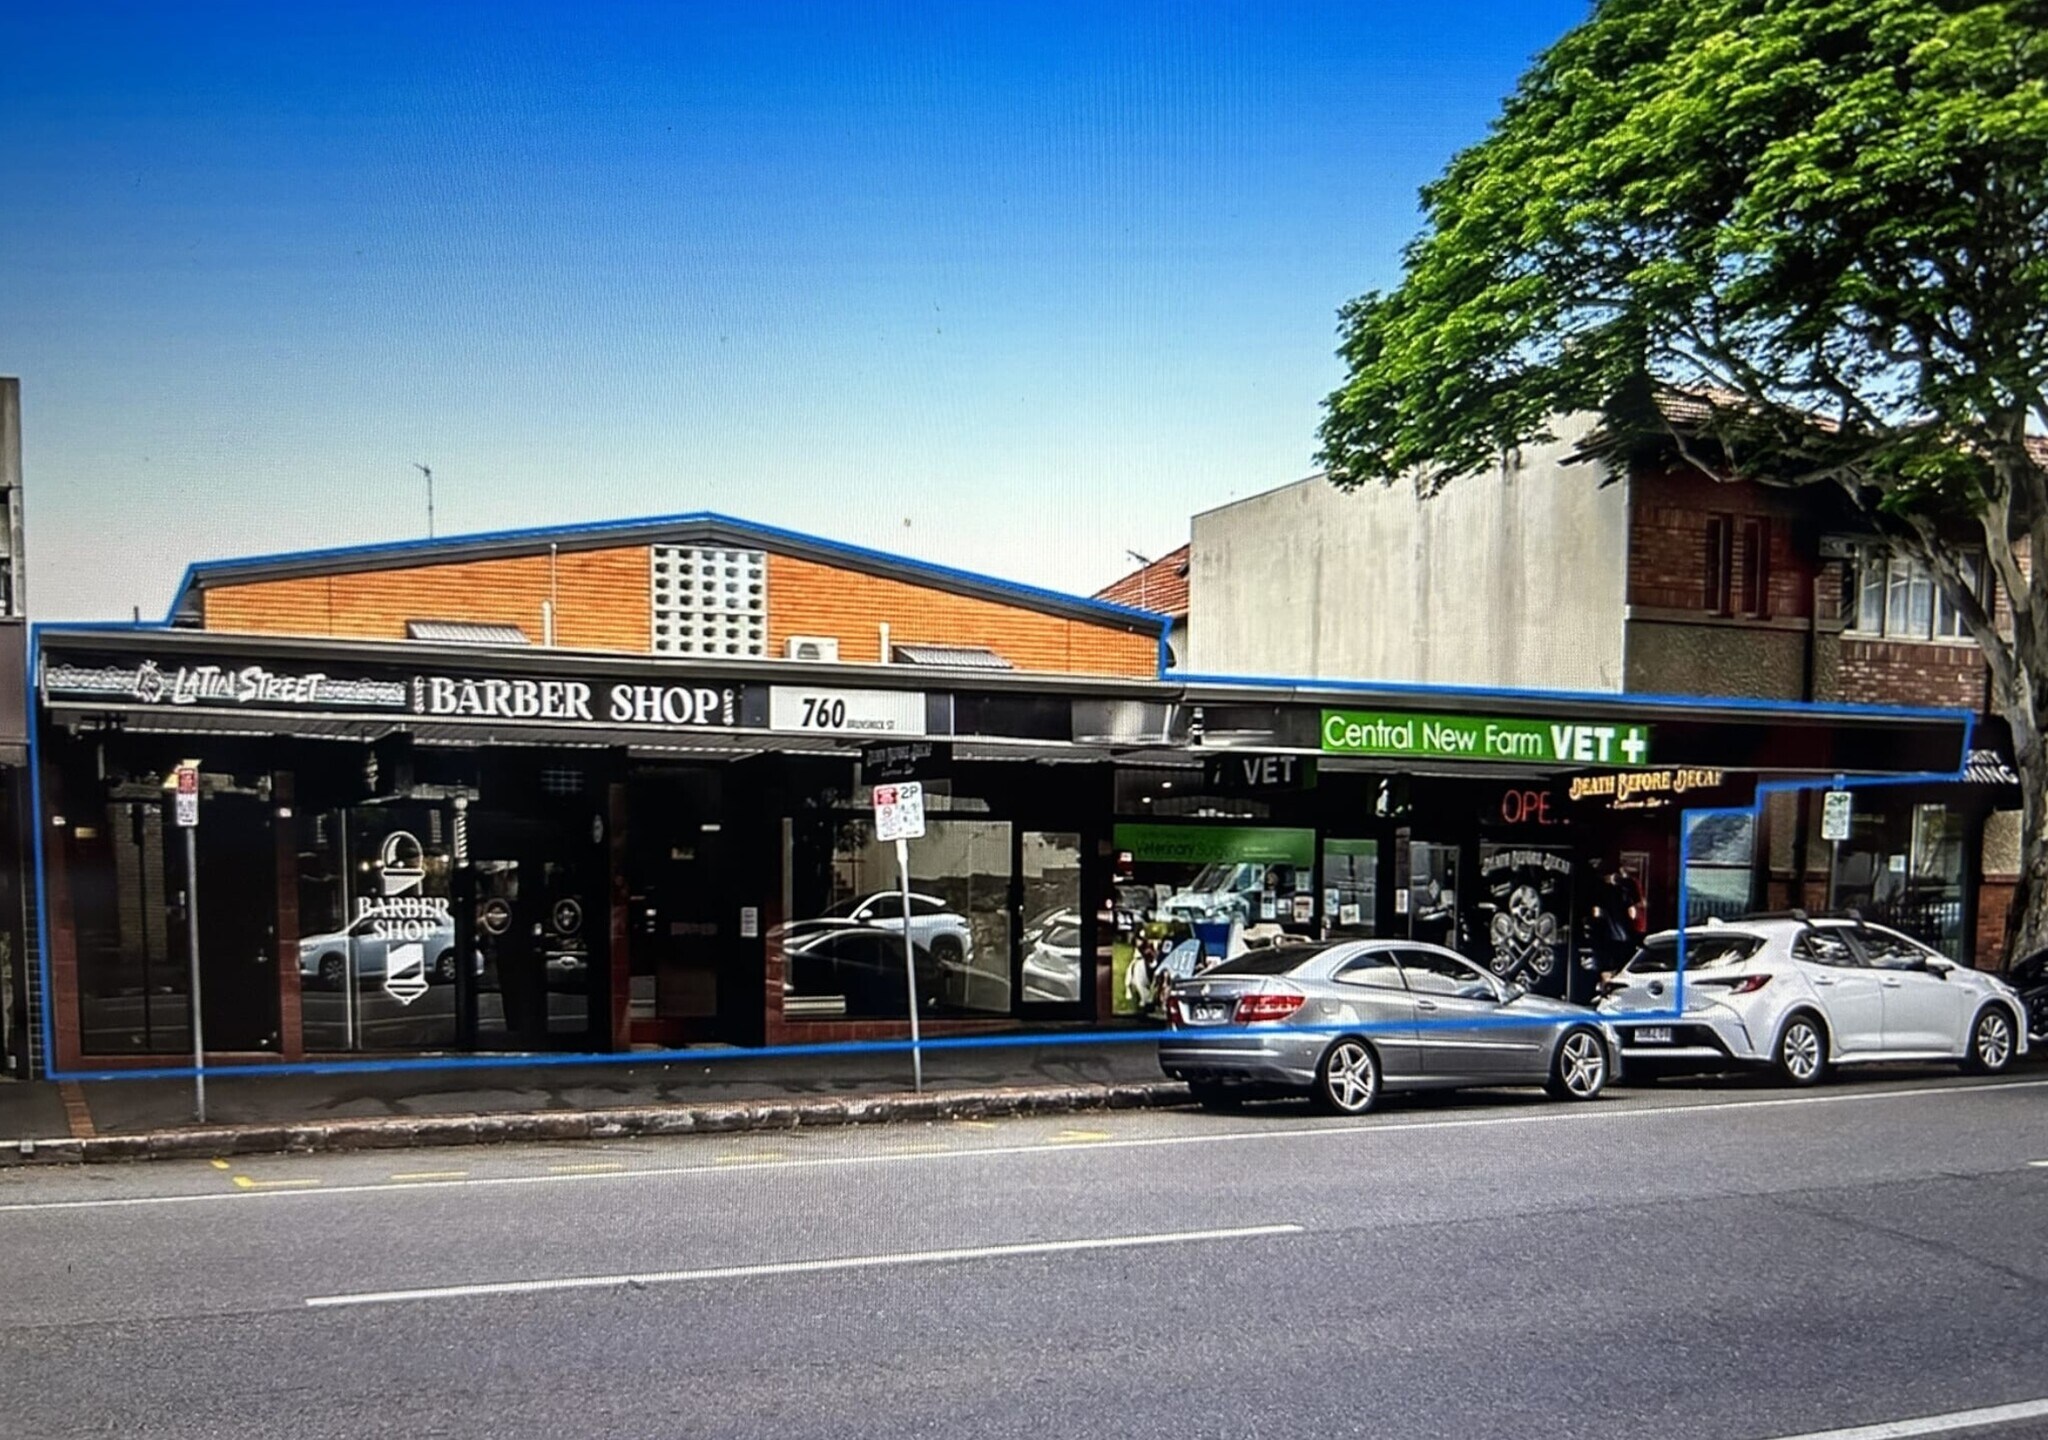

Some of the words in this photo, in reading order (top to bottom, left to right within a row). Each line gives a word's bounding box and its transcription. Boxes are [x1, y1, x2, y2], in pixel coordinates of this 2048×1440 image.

[172, 666, 235, 704] LATIN
[238, 665, 326, 704] STREET
[429, 676, 594, 720] BARBER
[610, 684, 719, 724] SHOP
[801, 698, 846, 728] 760
[1324, 715, 1413, 750] Central
[1422, 721, 1477, 751] New
[1485, 724, 1543, 756] Farm
[1550, 725, 1615, 762] VET
[1243, 755, 1297, 785] VET
[900, 785, 919, 799] 2P
[1569, 775, 1615, 800] DEATH
[1618, 771, 1671, 800] BEFORE
[358, 897, 450, 918] BARBER
[373, 919, 437, 941] SHOP
